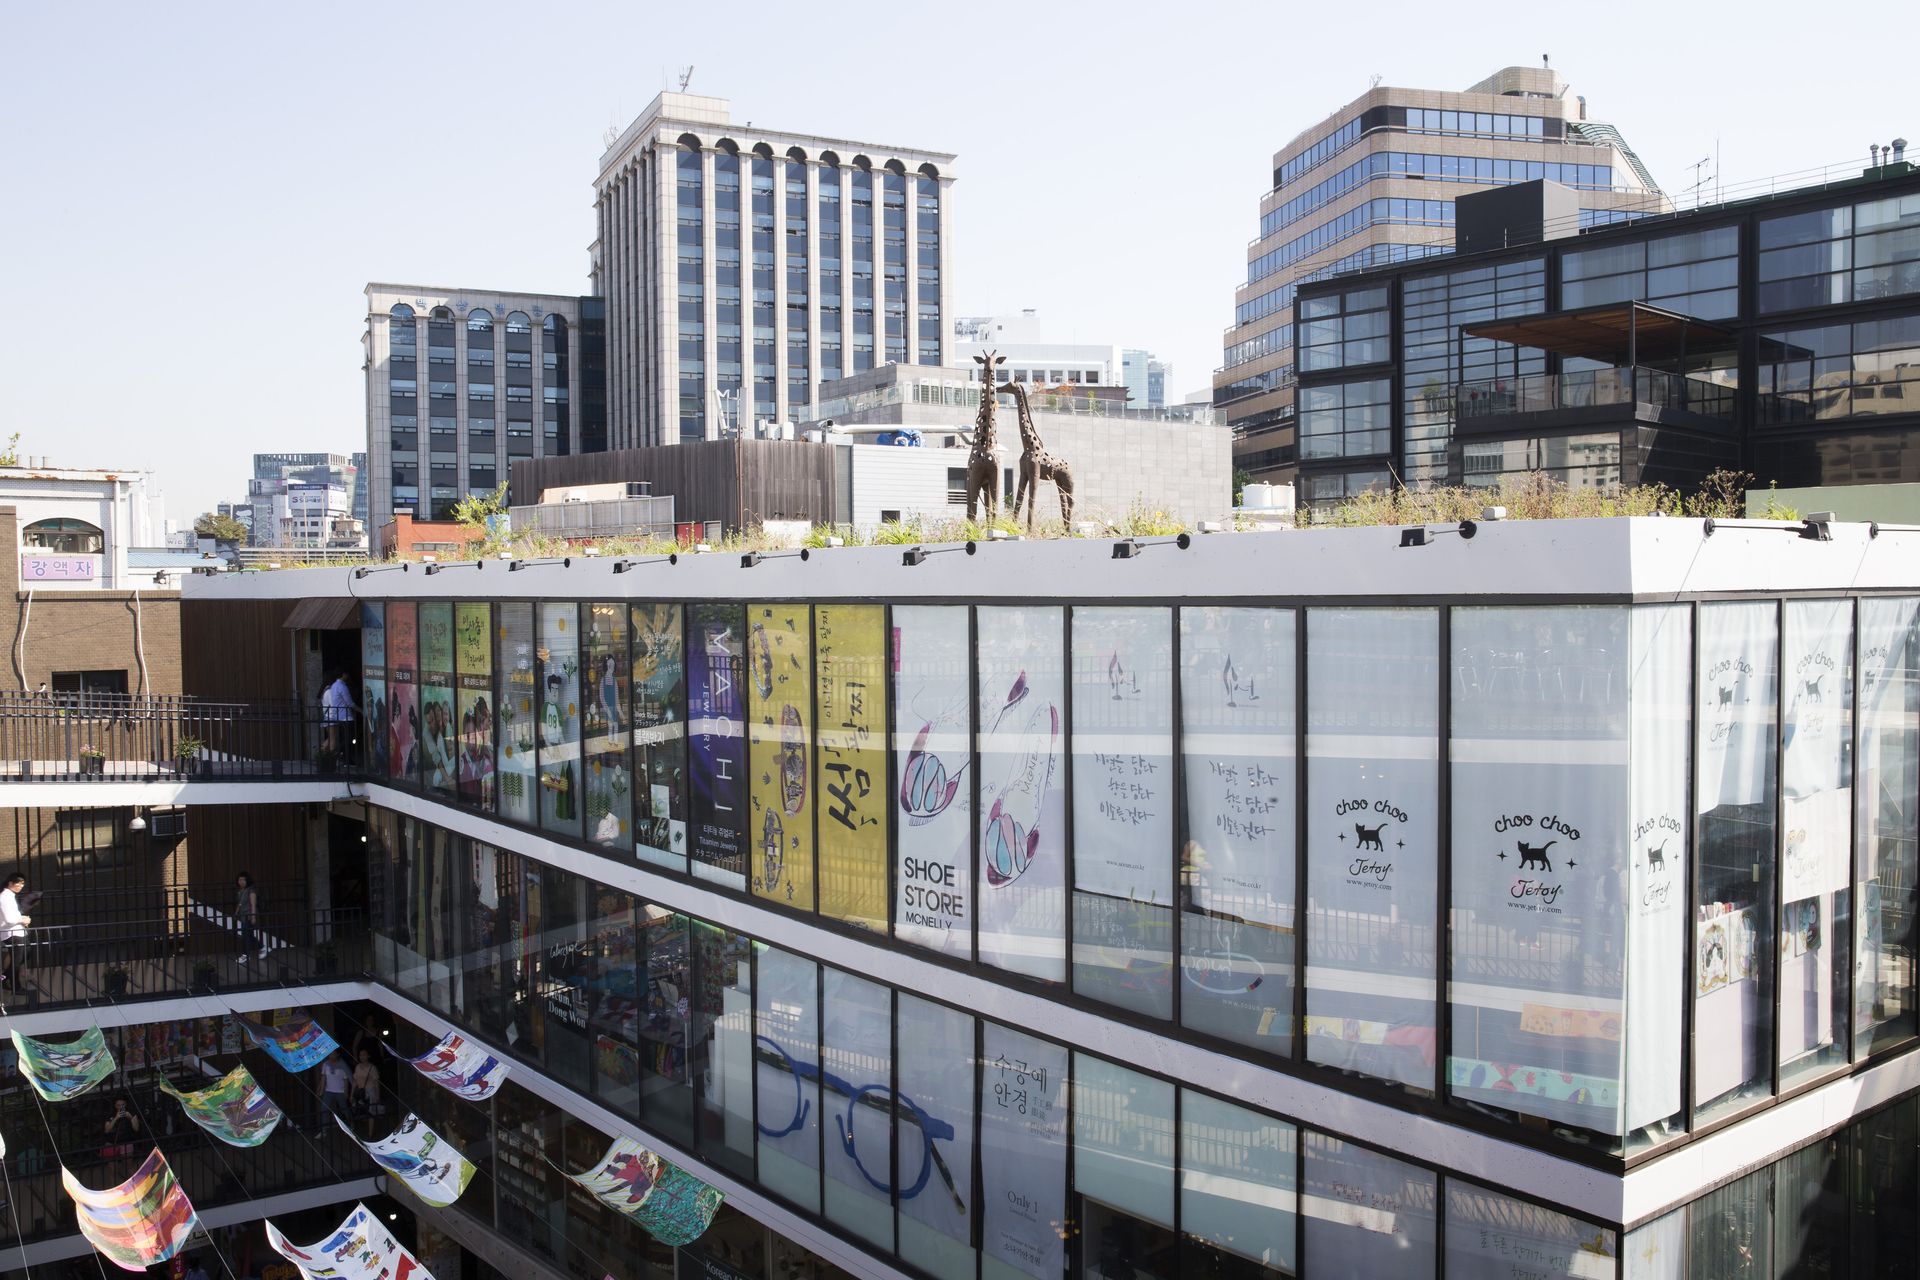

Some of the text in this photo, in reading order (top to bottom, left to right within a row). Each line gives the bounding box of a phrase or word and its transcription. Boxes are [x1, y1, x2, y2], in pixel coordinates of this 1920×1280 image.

[1708, 659, 1731, 681] choo
[548, 714, 557, 728] 08
[635, 729, 665, 746] 블랙반지
[1336, 799, 1408, 823] choo choo
[1495, 814, 1581, 840] choo choo
[1659, 813, 1681, 833] choo
[904, 856, 955, 887] SHOE
[1349, 858, 1391, 881] Jetoy
[1346, 879, 1392, 891] www.jetoy.com
[1511, 880, 1561, 904] Jetoy
[904, 887, 964, 918] STORE
[905, 913, 953, 931] MCNELLY
[548, 1000, 586, 1029] Dong Won
[994, 1053, 1047, 1094] 수공예
[994, 1082, 1027, 1114] 안경
[1007, 1190, 1038, 1213] Only 1
